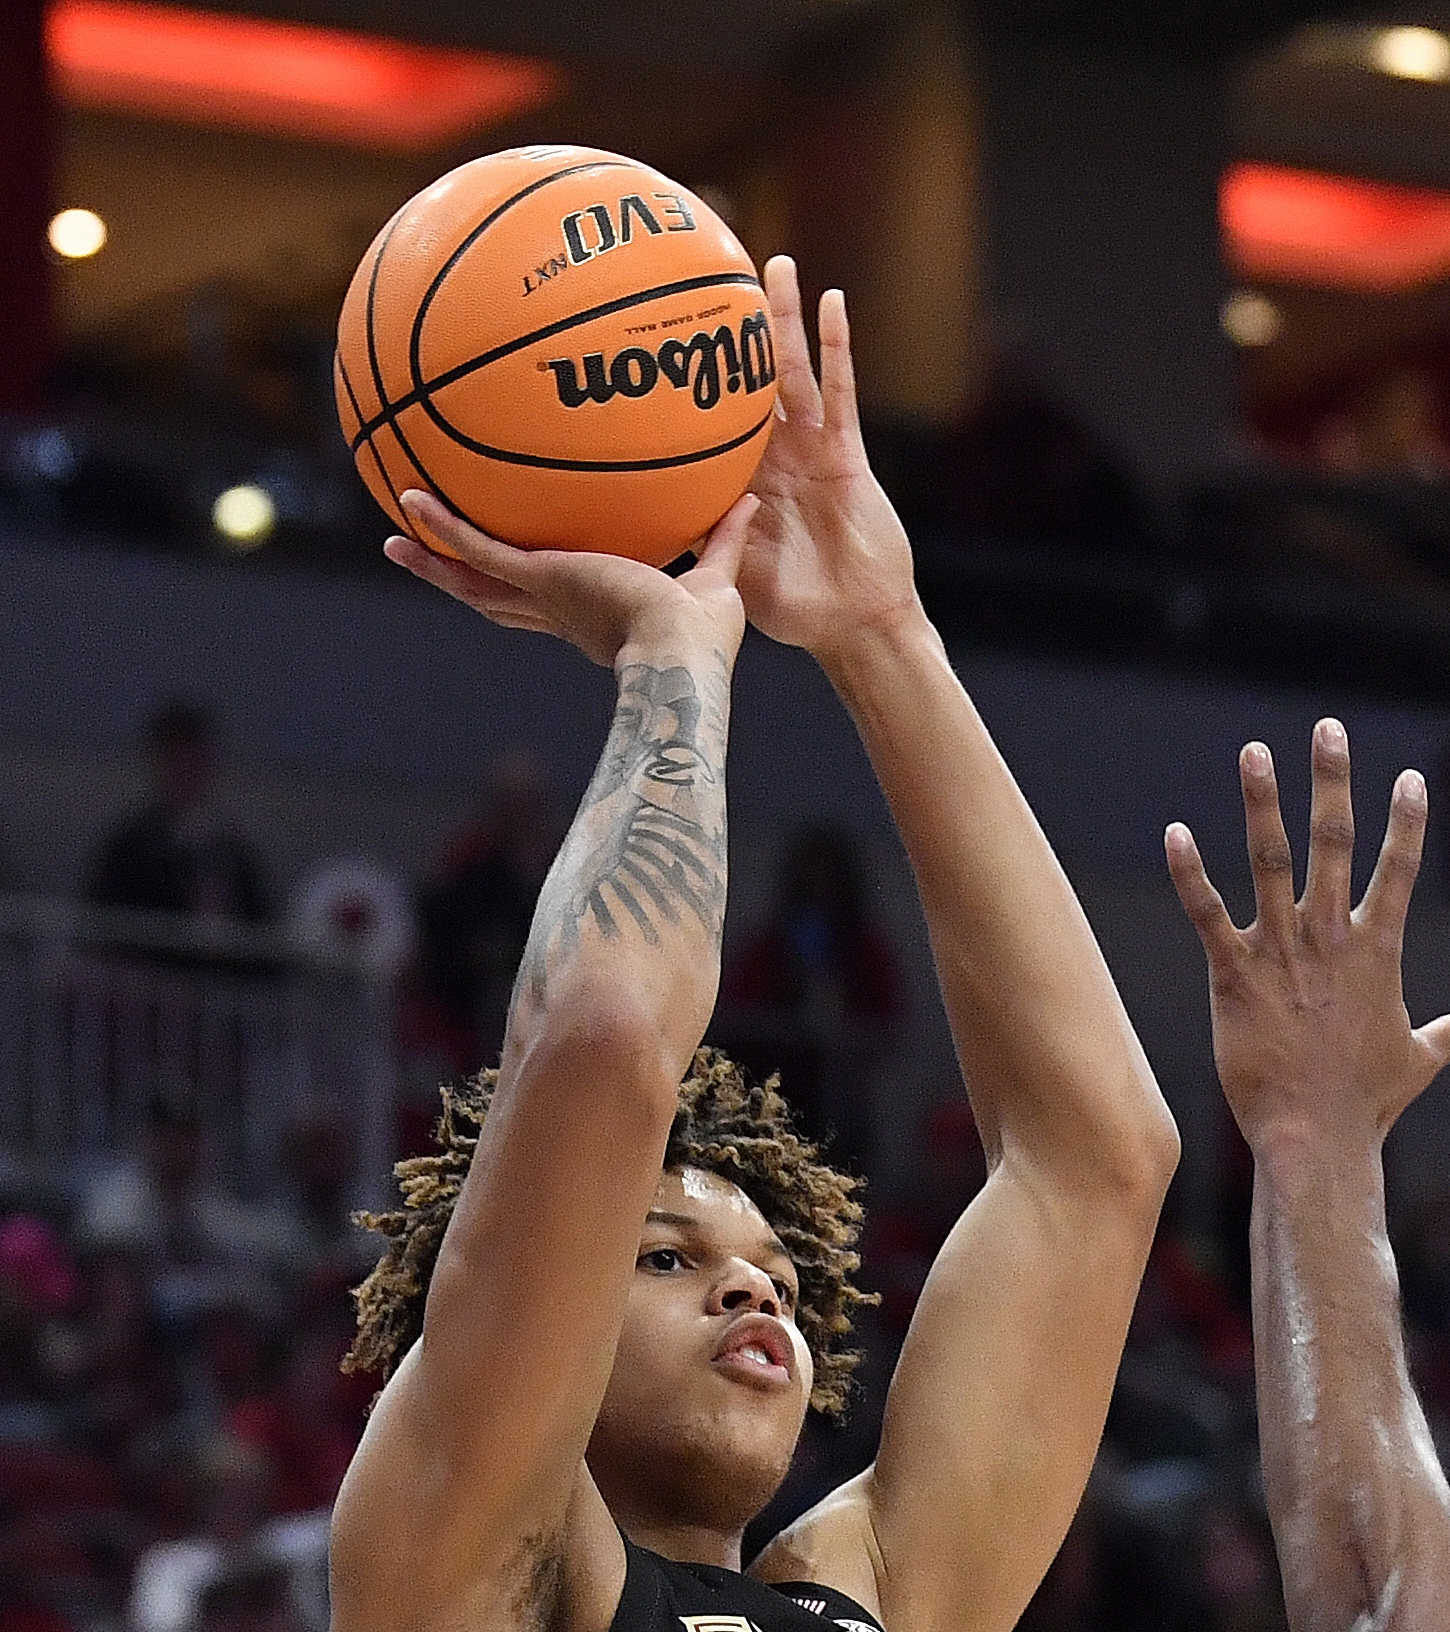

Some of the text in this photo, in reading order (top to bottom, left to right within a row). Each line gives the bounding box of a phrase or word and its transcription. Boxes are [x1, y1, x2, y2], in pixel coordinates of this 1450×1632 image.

[522, 190, 698, 297] EVO NXT
[624, 323, 657, 335] BALL
[660, 315, 694, 329] GAME
[549, 309, 776, 410] Wilson
